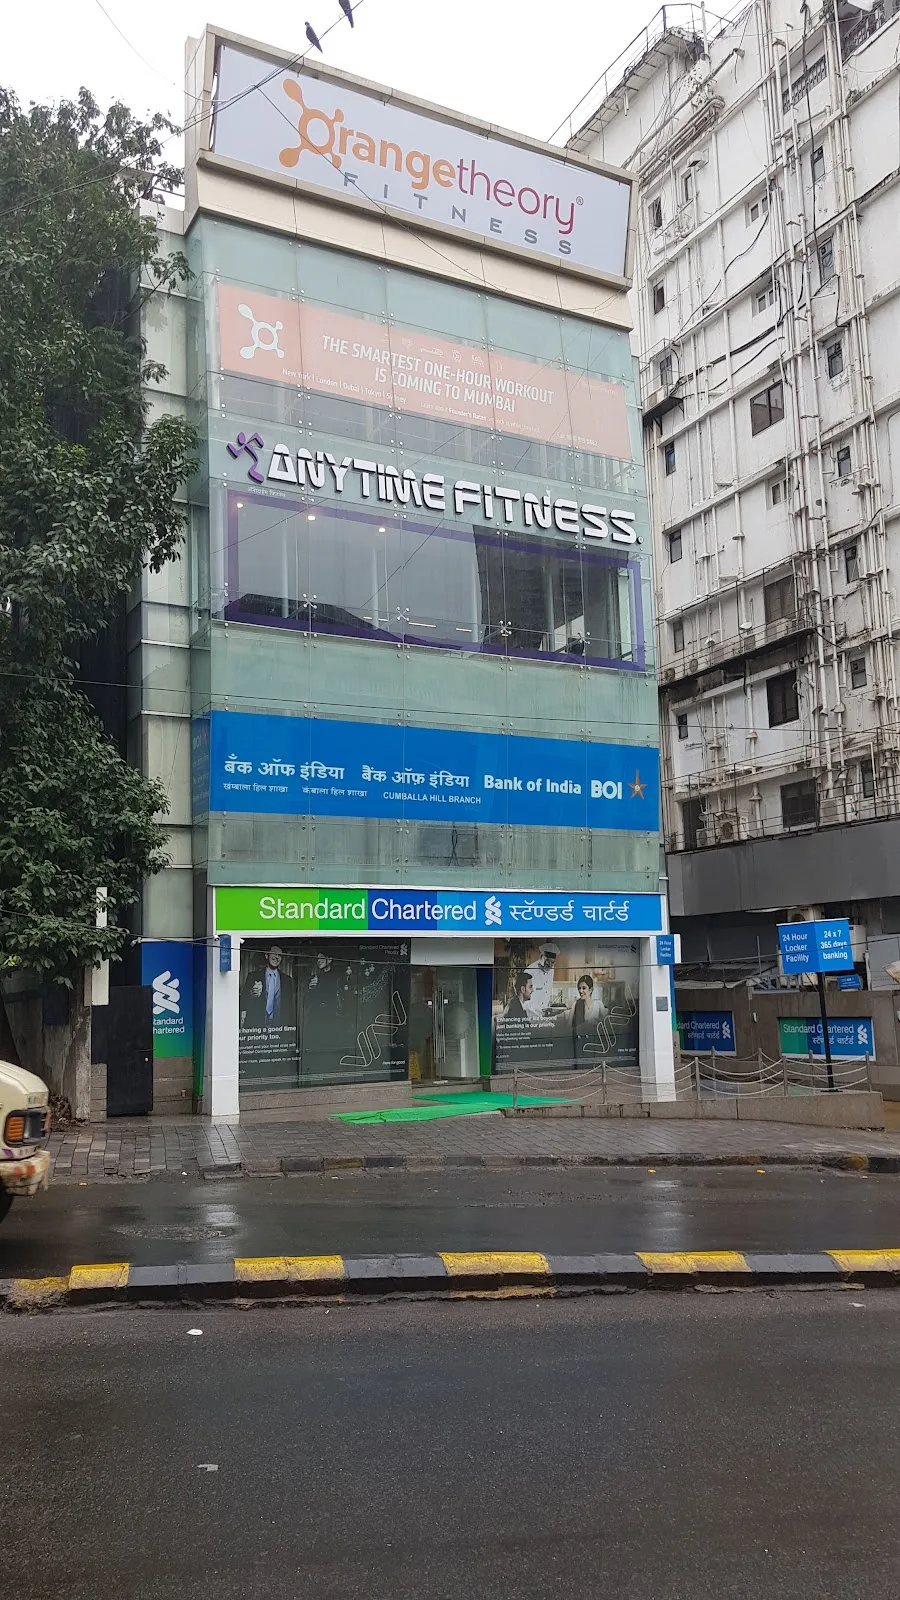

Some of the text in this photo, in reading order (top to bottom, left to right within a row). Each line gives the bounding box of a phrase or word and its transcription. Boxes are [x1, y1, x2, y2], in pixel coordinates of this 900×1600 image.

[343, 171, 572, 256] FITNESS
[322, 335, 349, 355] THE
[352, 343, 421, 372] SMARTEST
[424, 361, 492, 389] ONE-HOUR
[495, 377, 555, 405] WORKOUT
[317, 377, 338, 388] London
[364, 387, 382, 398] Tokyo
[375, 367, 516, 413] IS COMING TO MUMBAI
[448, 407, 473, 419] Founder's
[473, 412, 487, 421] Rates
[268, 443, 637, 545] ANYTIME FITNESS
[224, 753, 345, 781] बँक ऑफ इंडिया
[361, 764, 387, 782] बैंक
[429, 770, 469, 788] इंडिया
[484, 774, 623, 800] Bank of India BOI
[383, 791, 481, 804] CUMBALLA HILL BRANCH
[259, 896, 477, 921] Standard Chartered
[582, 900, 630, 922] चार्टर्ड
[782, 933, 808, 942] 24 Hour
[823, 930, 832, 938] 24
[837, 930, 842, 938] 7
[785, 944, 808, 952] Locker
[820, 940, 848, 949] 365 days
[785, 953, 810, 963] Facility
[823, 951, 848, 960] banking
[153, 1016, 184, 1026] tandard
[690, 1021, 720, 1030] Chartered
[153, 1026, 185, 1035] hartered
[783, 1023, 854, 1034] Standard Cartered
